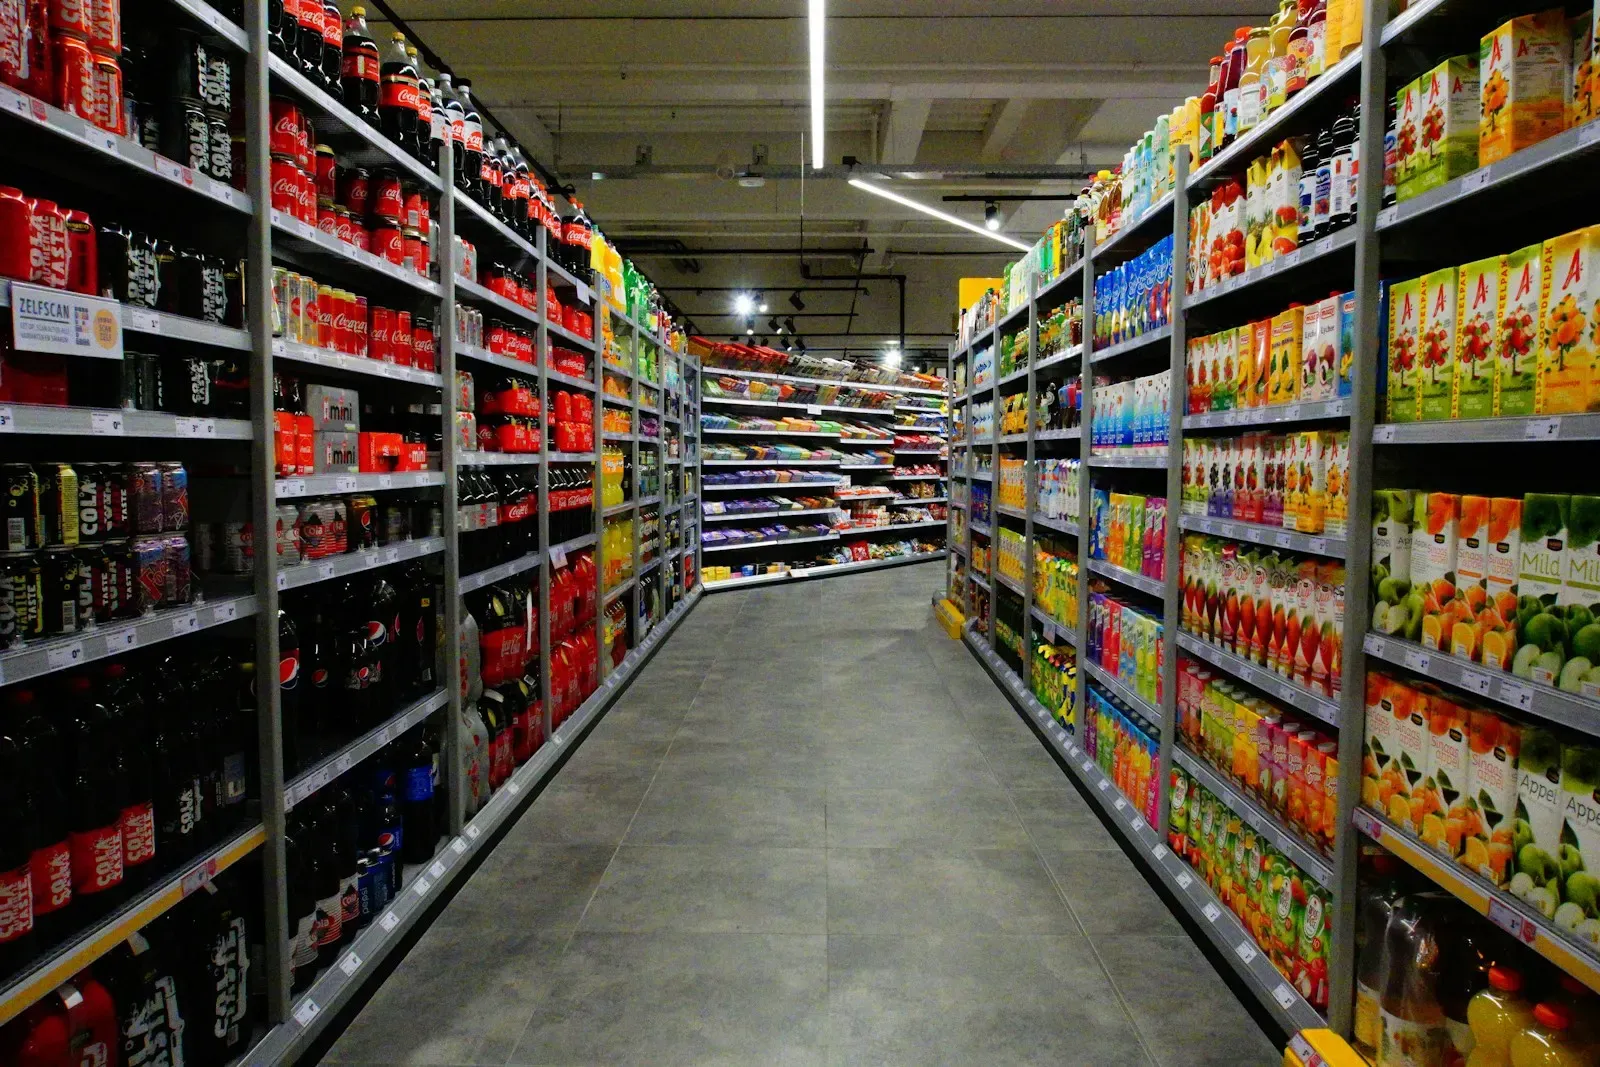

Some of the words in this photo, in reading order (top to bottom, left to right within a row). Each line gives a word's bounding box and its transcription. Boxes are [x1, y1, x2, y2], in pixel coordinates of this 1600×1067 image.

[81, 58, 94, 114] COLA
[94, 69, 110, 122] TASTE
[207, 58, 221, 106] COLA
[211, 133, 226, 179] COLA
[51, 215, 65, 288] TASTE
[20, 298, 70, 319] ZELFSCAN
[1456, 270, 1467, 361] VOORDEELPAK
[1496, 260, 1508, 356] VOORDEELPAK
[1540, 246, 1553, 350] VOORDEELPAK
[1418, 280, 1428, 366] VOORDEELPAK
[331, 403, 352, 421] mini
[333, 446, 355, 465] mini
[80, 481, 98, 535] COLA
[1521, 552, 1560, 577] Mild
[1569, 558, 1600, 583] Mil
[28, 585, 37, 620] TASTE
[1431, 735, 1459, 757] Sinaas
[1472, 753, 1504, 777] Sinaas
[181, 788, 194, 834] COLA
[1520, 774, 1557, 805] Appel
[1566, 796, 1600, 827] Appe
[126, 813, 141, 861] COLA
[51, 852, 66, 906] COLA
[95, 837, 111, 887] COLA
[361, 887, 369, 914] pepsi
